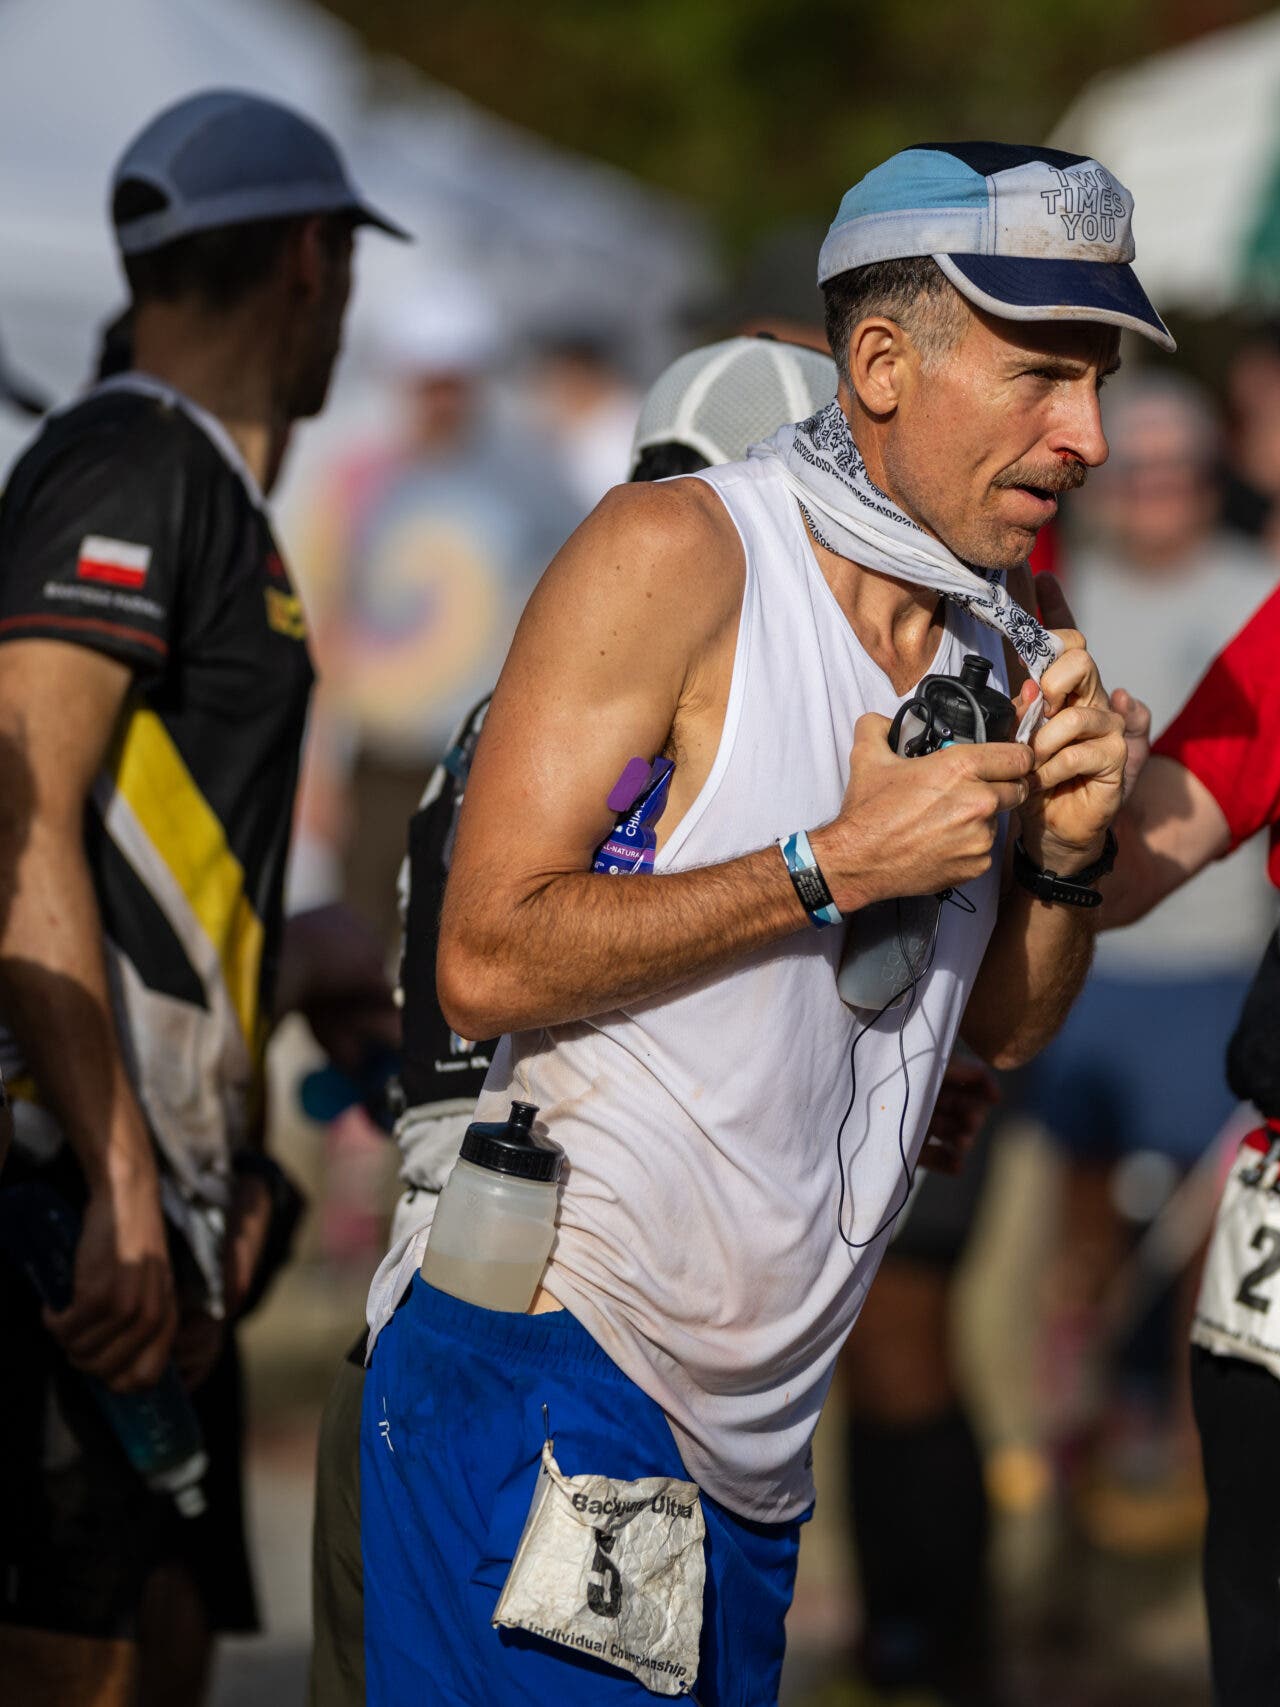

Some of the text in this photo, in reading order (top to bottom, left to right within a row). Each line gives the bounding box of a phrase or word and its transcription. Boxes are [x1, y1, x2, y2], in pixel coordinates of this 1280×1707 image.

[1048, 167, 1112, 190] TWO
[1041, 187, 1126, 218] TIMES
[1061, 214, 1116, 242] YOU
[625, 809, 642, 837] CHIA
[651, 1495, 693, 1519] Ultra
[587, 1527, 622, 1618] 5
[528, 1622, 607, 1654] Individual
